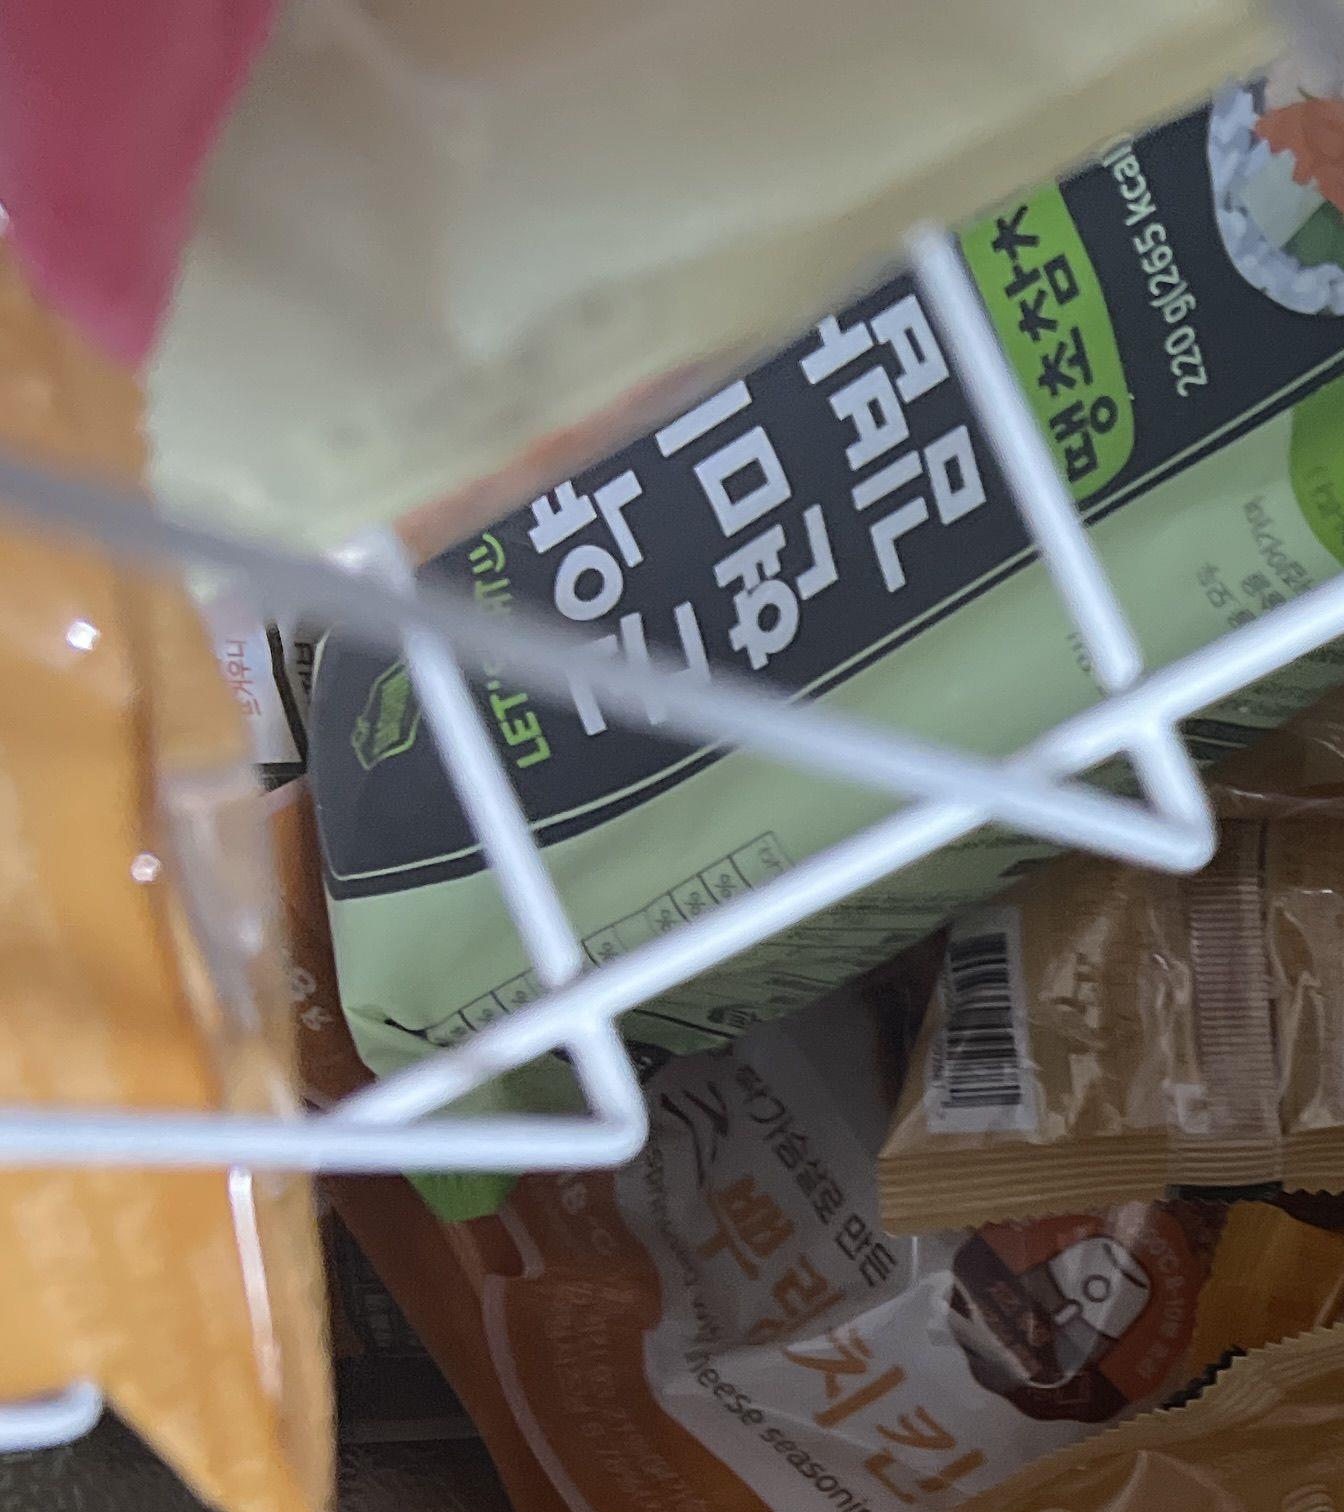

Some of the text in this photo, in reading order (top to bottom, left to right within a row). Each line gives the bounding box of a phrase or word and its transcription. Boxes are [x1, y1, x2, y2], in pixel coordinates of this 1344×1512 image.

[799, 294, 989, 593] 김밥
[1163, 323, 1209, 397] 220
[655, 381, 841, 670] 현미
